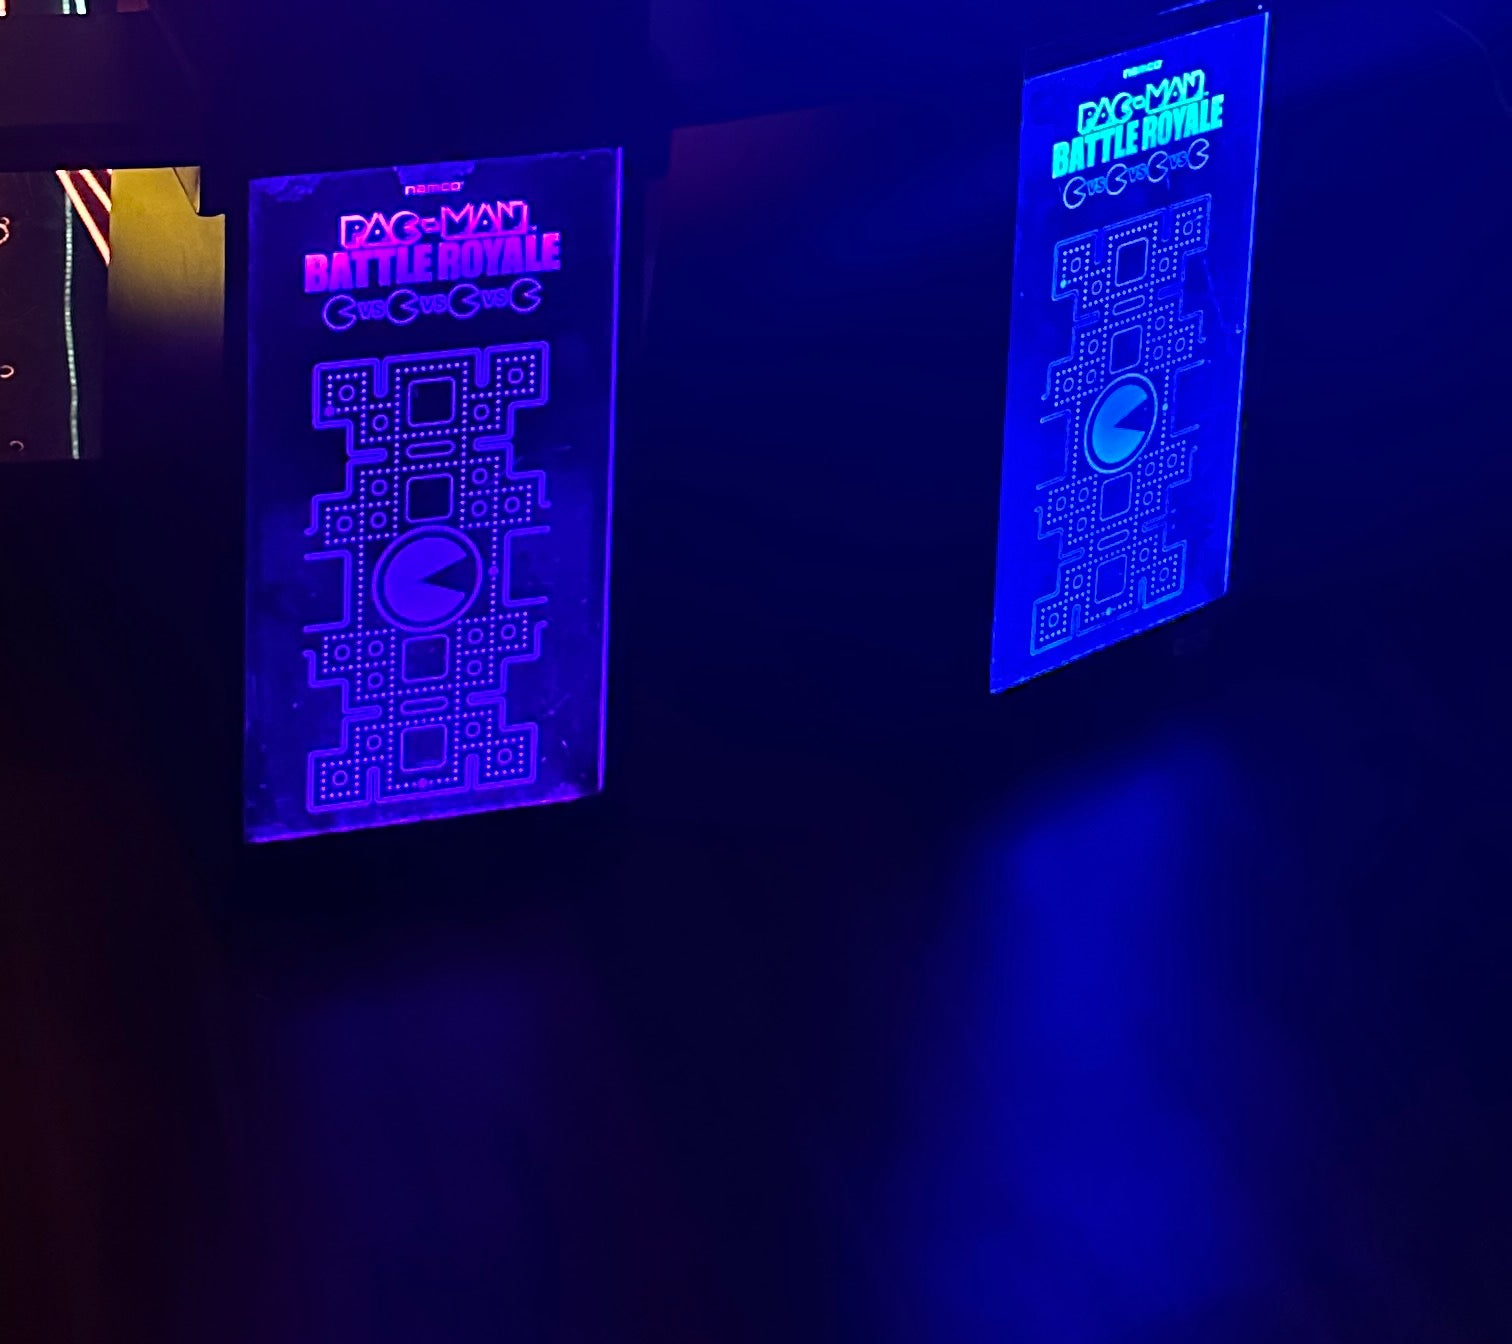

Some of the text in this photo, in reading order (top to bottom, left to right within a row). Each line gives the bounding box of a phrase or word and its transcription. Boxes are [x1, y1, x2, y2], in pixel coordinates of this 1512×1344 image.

[1078, 69, 1205, 135] PAC-MAN
[1052, 93, 1224, 180] BATTLE ROYALE
[404, 180, 465, 196] namco
[339, 199, 529, 250] PAC-MAN
[303, 231, 561, 294] BATTLE ROYALE
[357, 287, 510, 320] VS VS VS
